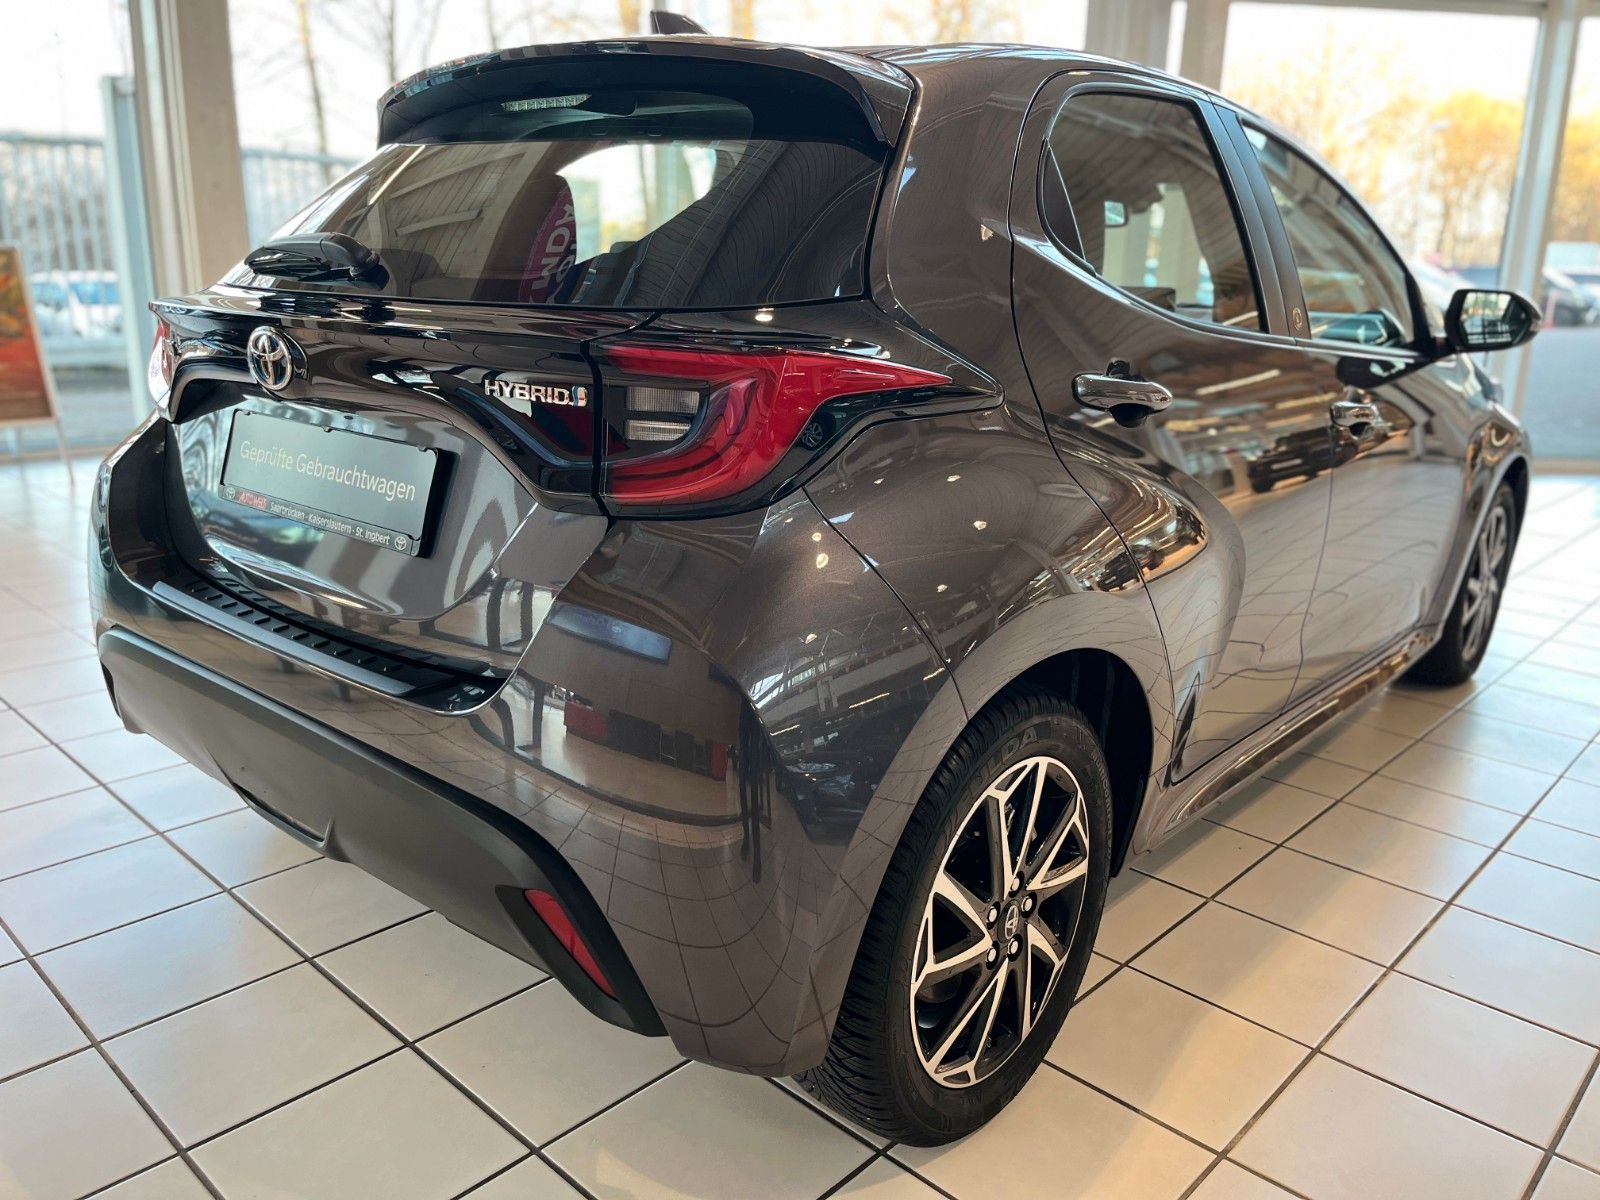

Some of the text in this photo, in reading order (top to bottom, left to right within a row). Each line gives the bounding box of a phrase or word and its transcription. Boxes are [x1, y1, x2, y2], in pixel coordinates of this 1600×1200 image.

[484, 380, 570, 405] HYBRID
[240, 440, 416, 501] Geprüfte Gebrauchtwagen
[270, 502, 305, 520] Saarbrücken
[308, 513, 352, 534] Kaiserslautern
[355, 526, 364, 538] St.
[365, 529, 391, 545] Ingbert
